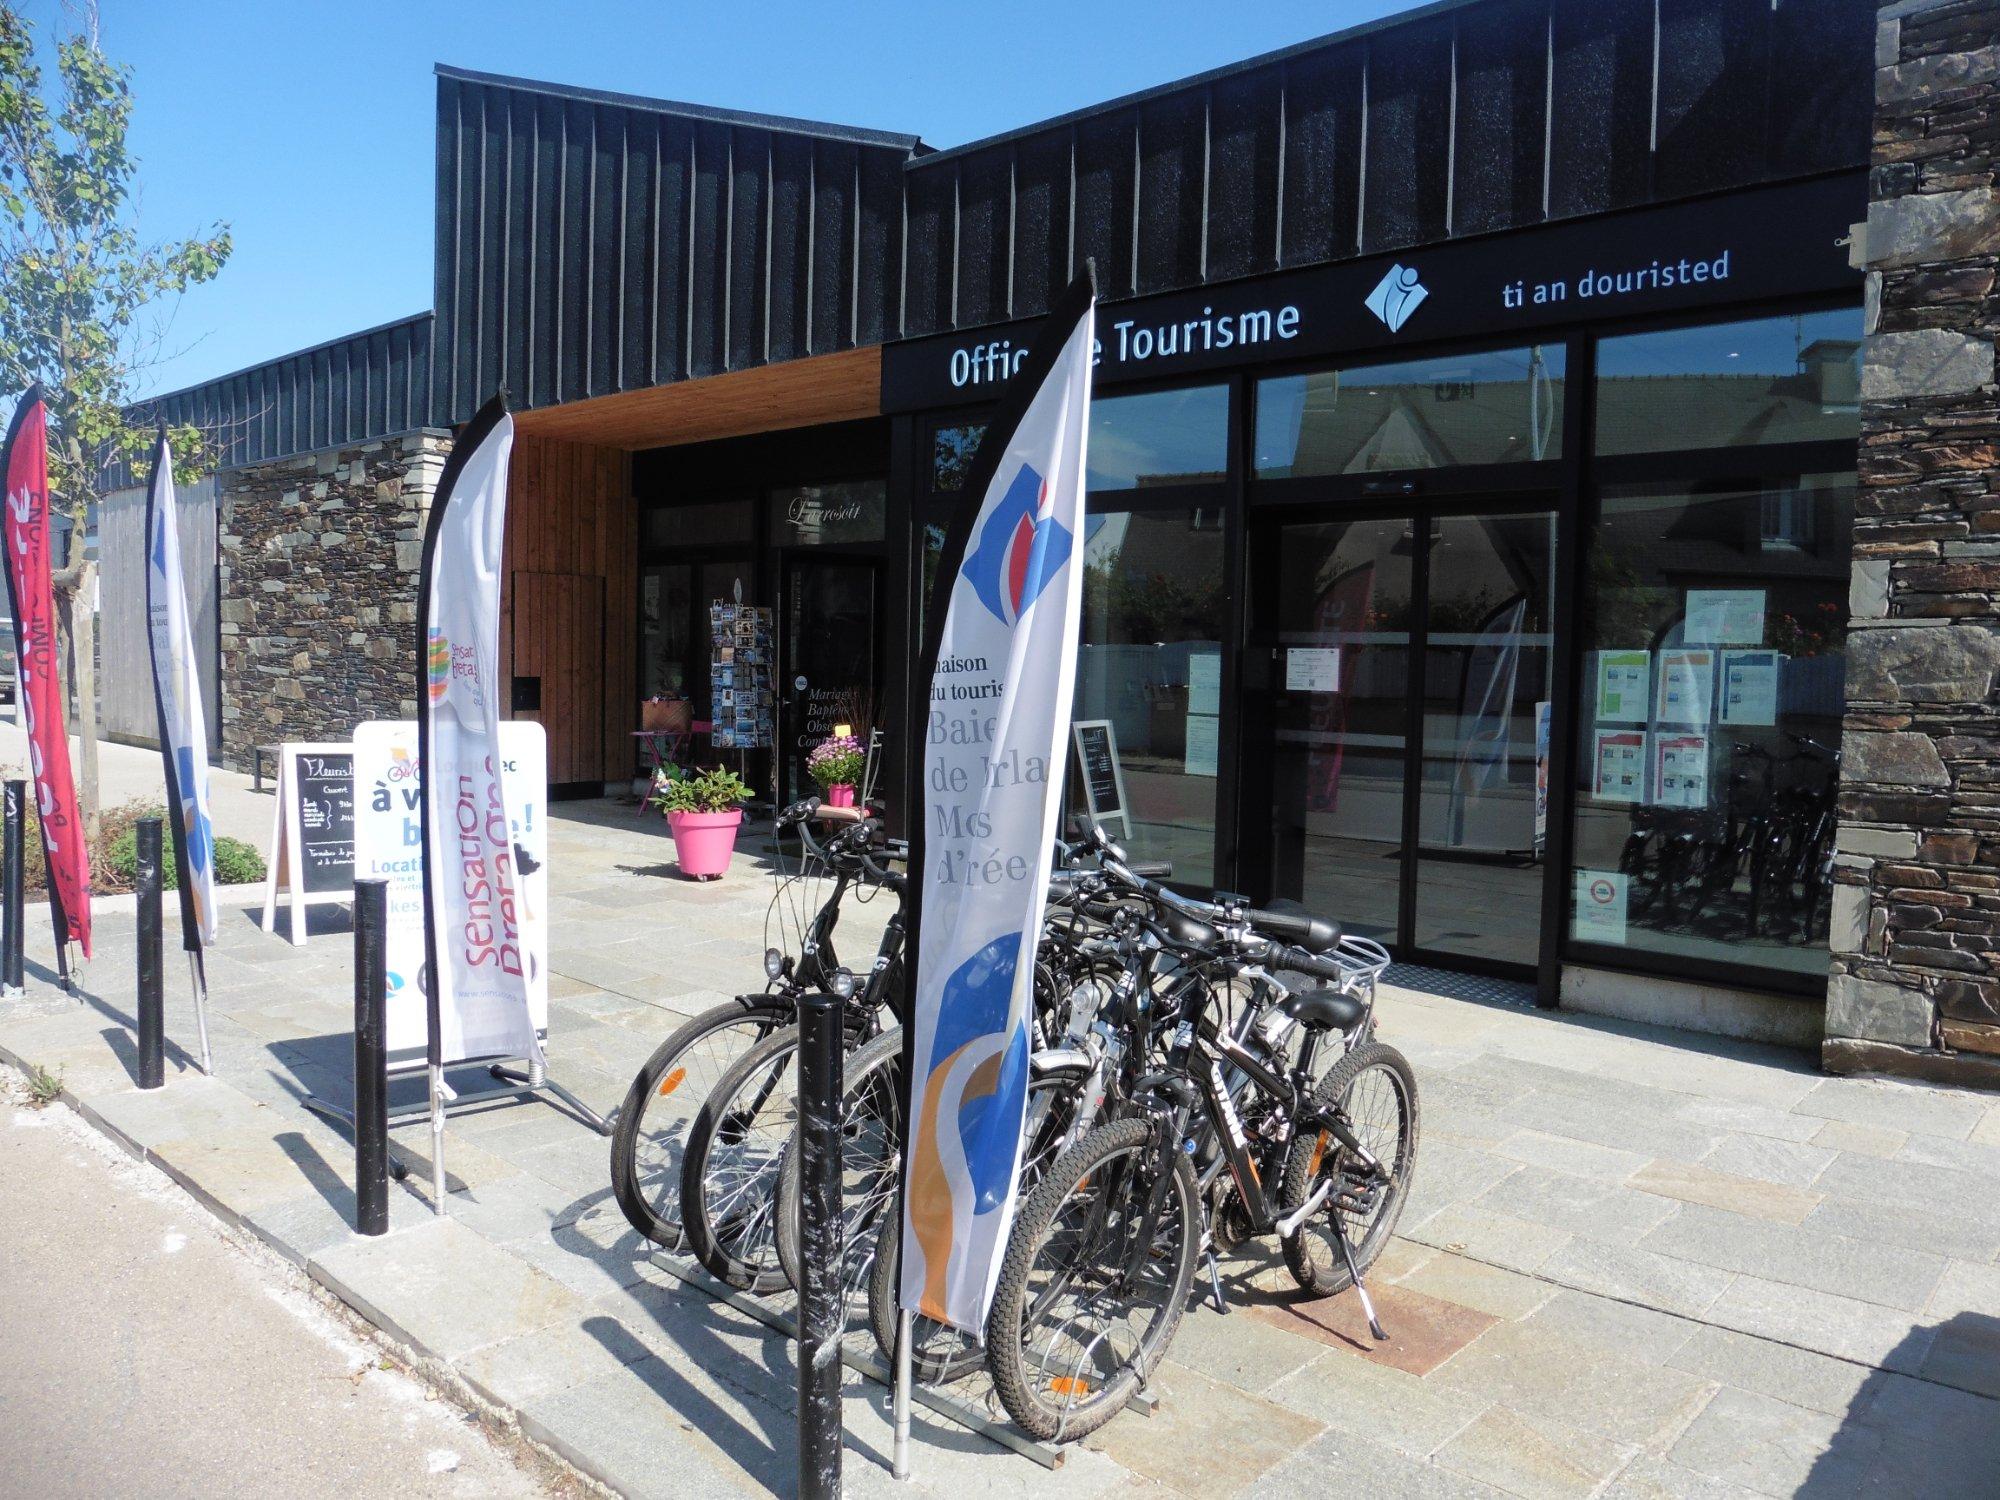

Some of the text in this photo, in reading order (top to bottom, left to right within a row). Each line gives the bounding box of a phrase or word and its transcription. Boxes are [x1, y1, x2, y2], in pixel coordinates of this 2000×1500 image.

[1502, 251, 1730, 308] ti an douristed
[950, 341, 1029, 387] Offic
[1113, 304, 1301, 362] Tourisme
[951, 680, 1003, 700] touris
[303, 758, 353, 776] Fleurist
[931, 756, 967, 792] de
[372, 780, 392, 812] à
[372, 855, 423, 873] Locati
[456, 775, 499, 966] Sensation
